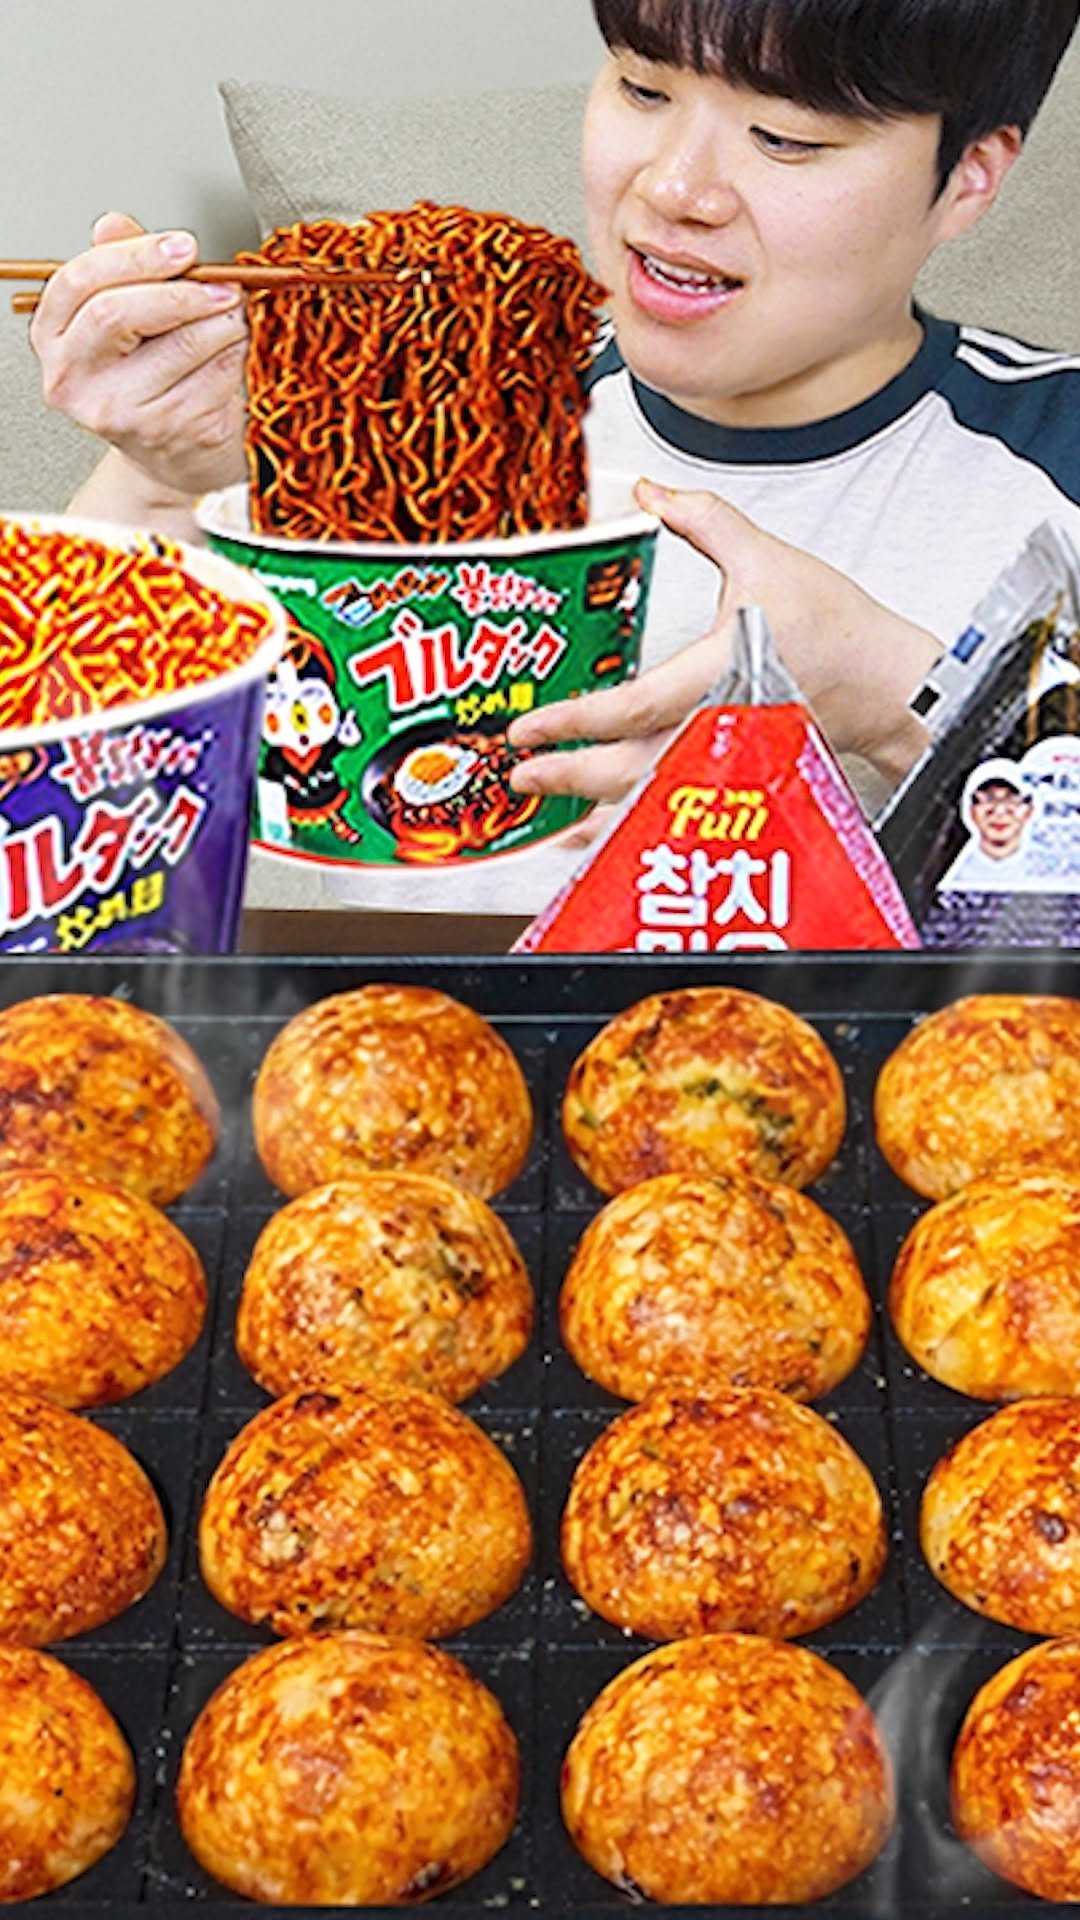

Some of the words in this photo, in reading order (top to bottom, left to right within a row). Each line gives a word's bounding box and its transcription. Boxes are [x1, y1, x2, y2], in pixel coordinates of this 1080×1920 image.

[350, 611, 564, 708] ブルダック
[0, 788, 205, 926] ルダック
[667, 785, 770, 841] Full
[636, 844, 791, 930] 참치
